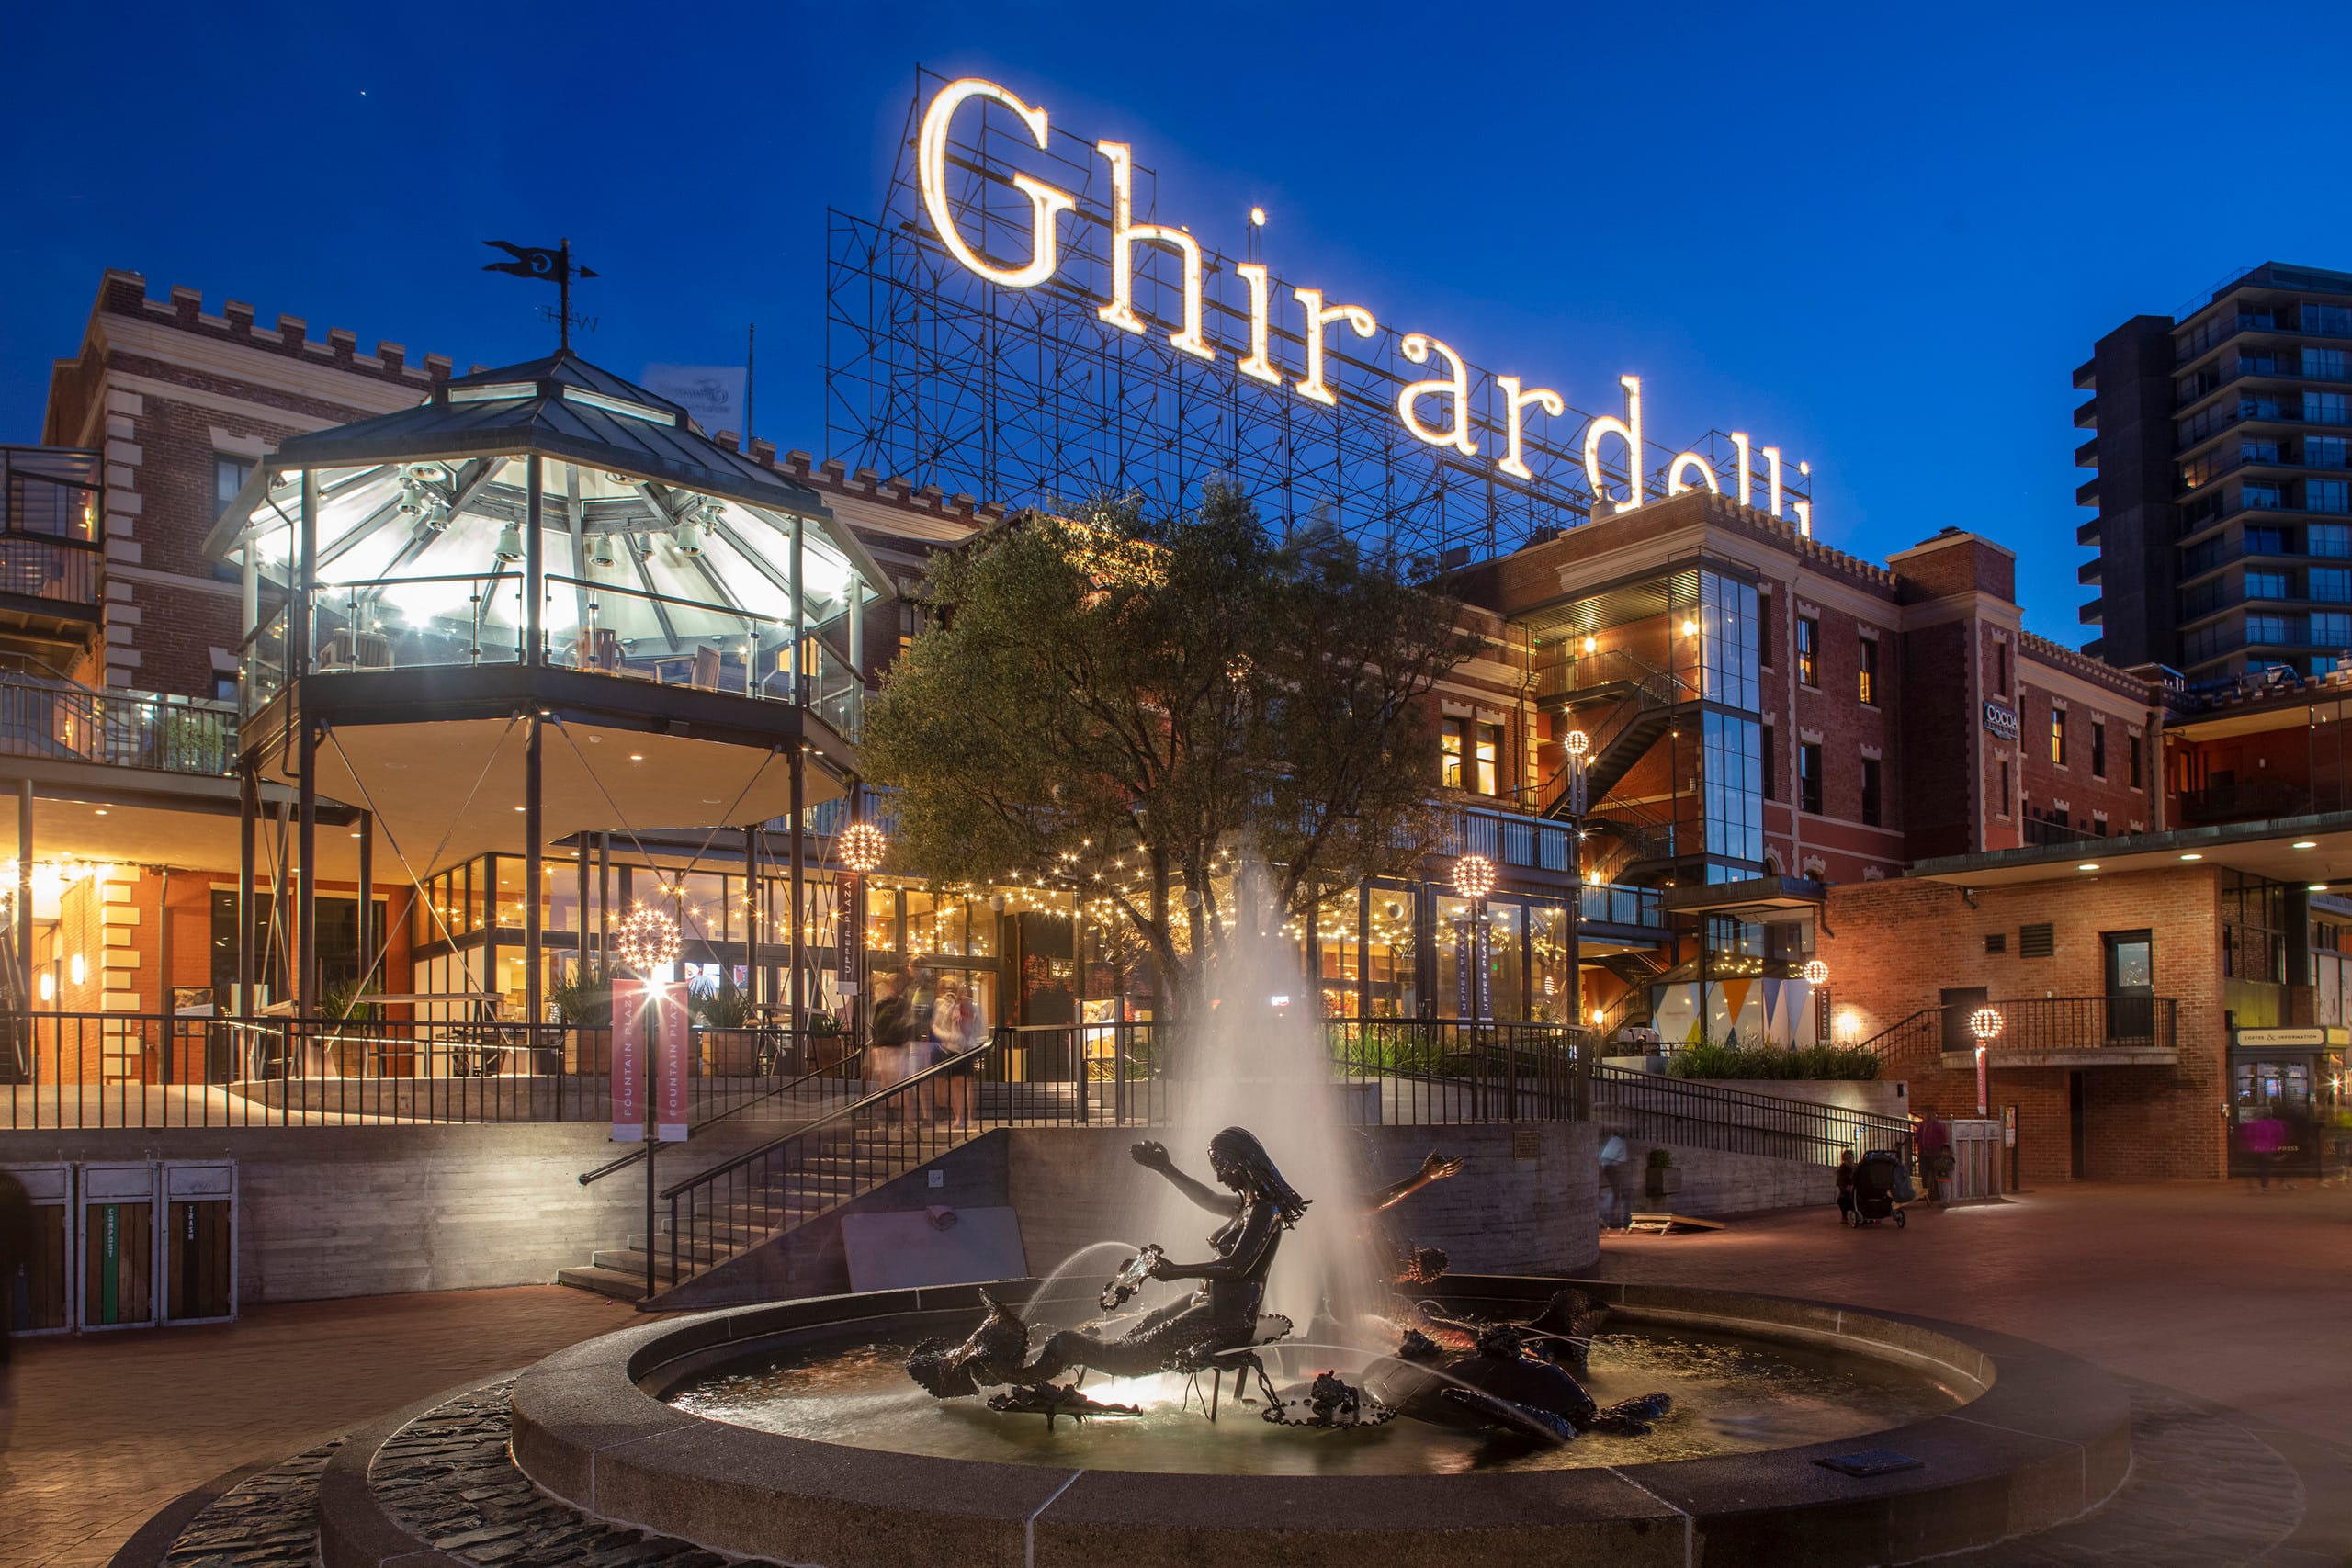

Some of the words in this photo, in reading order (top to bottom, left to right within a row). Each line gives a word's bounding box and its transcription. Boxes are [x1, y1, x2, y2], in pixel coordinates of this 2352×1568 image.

[919, 77, 1812, 541] Ghirardelli
[1987, 705, 2018, 729] COCOA
[624, 990, 632, 1036] PLAZA
[669, 992, 677, 1038] PLAZA
[624, 1043, 632, 1117] FOUNTAIN
[669, 1043, 677, 1117] FOUNTAIN
